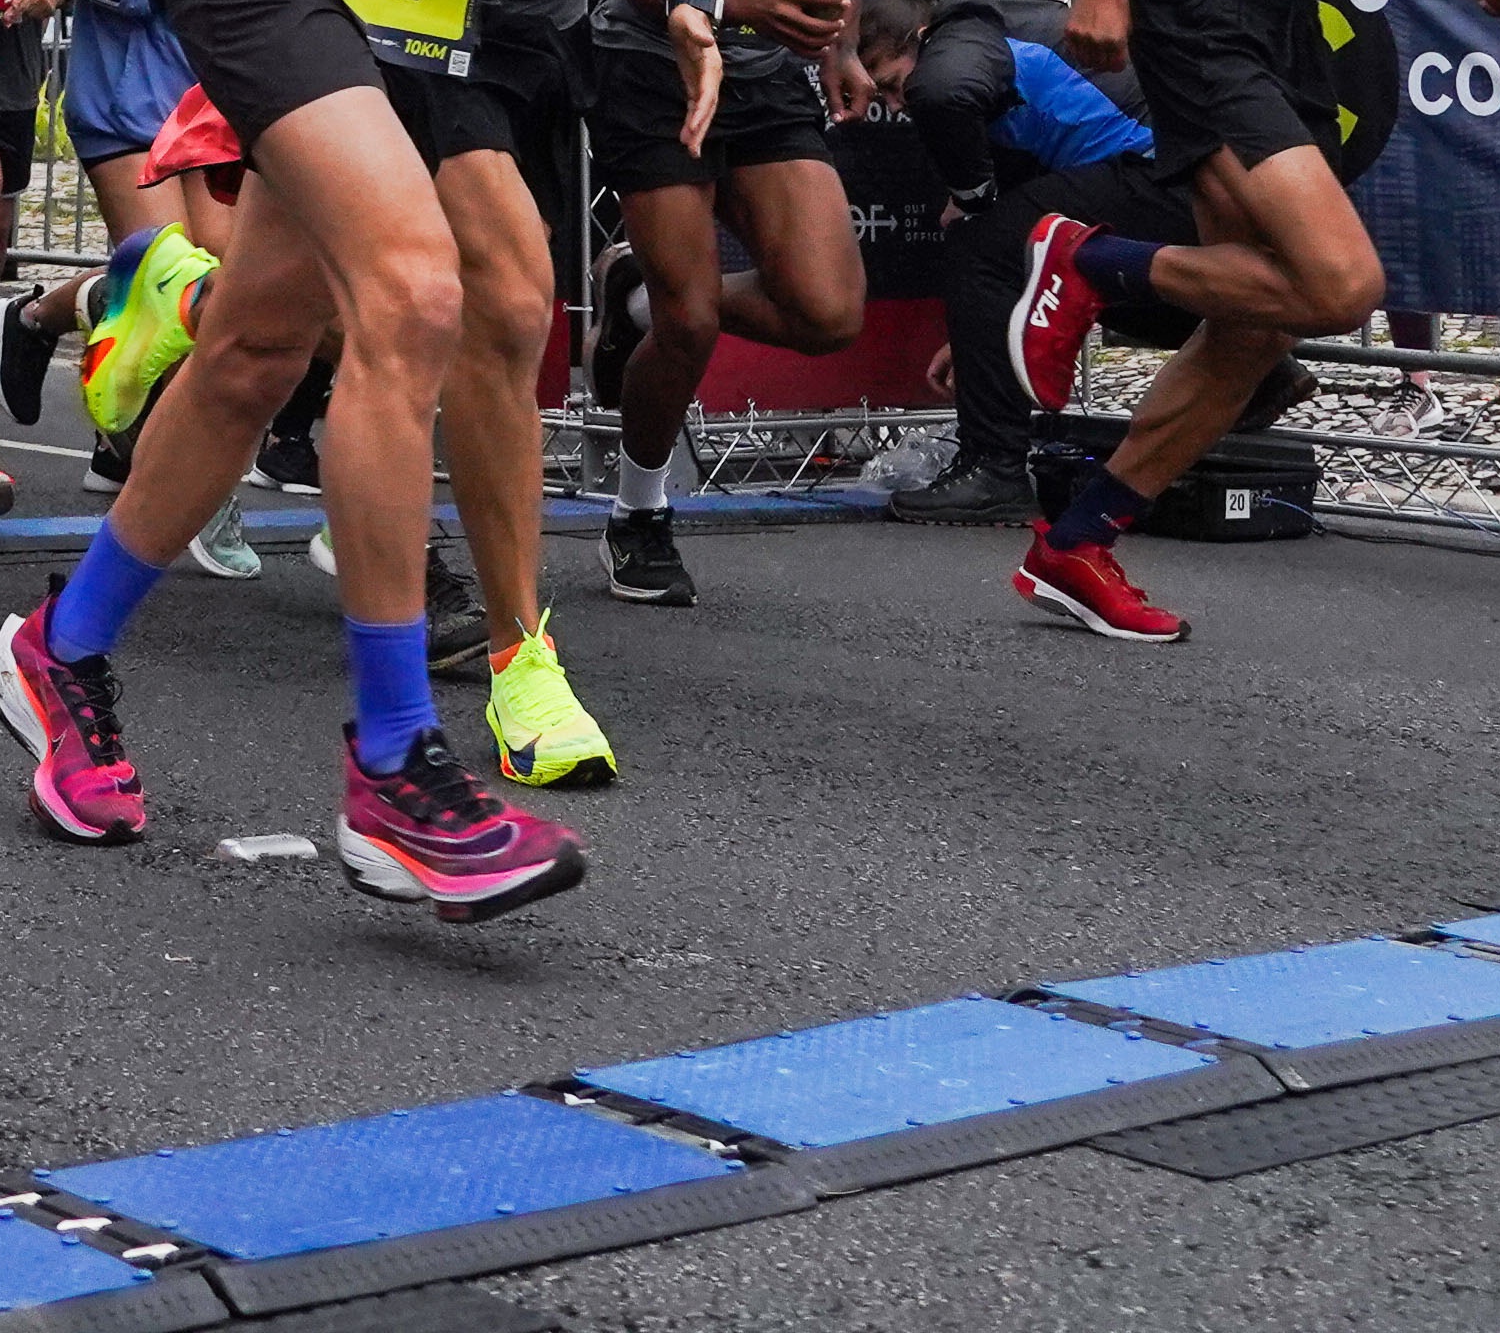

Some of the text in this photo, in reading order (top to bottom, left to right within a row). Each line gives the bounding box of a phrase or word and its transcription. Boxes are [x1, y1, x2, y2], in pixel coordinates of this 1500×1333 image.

[404, 39, 448, 60] 10KM
[905, 204, 926, 213] OUT
[905, 219, 918, 227] OF
[905, 233, 945, 242] OFFICE
[1030, 274, 1063, 328] FILA
[1229, 493, 1245, 511] 20
